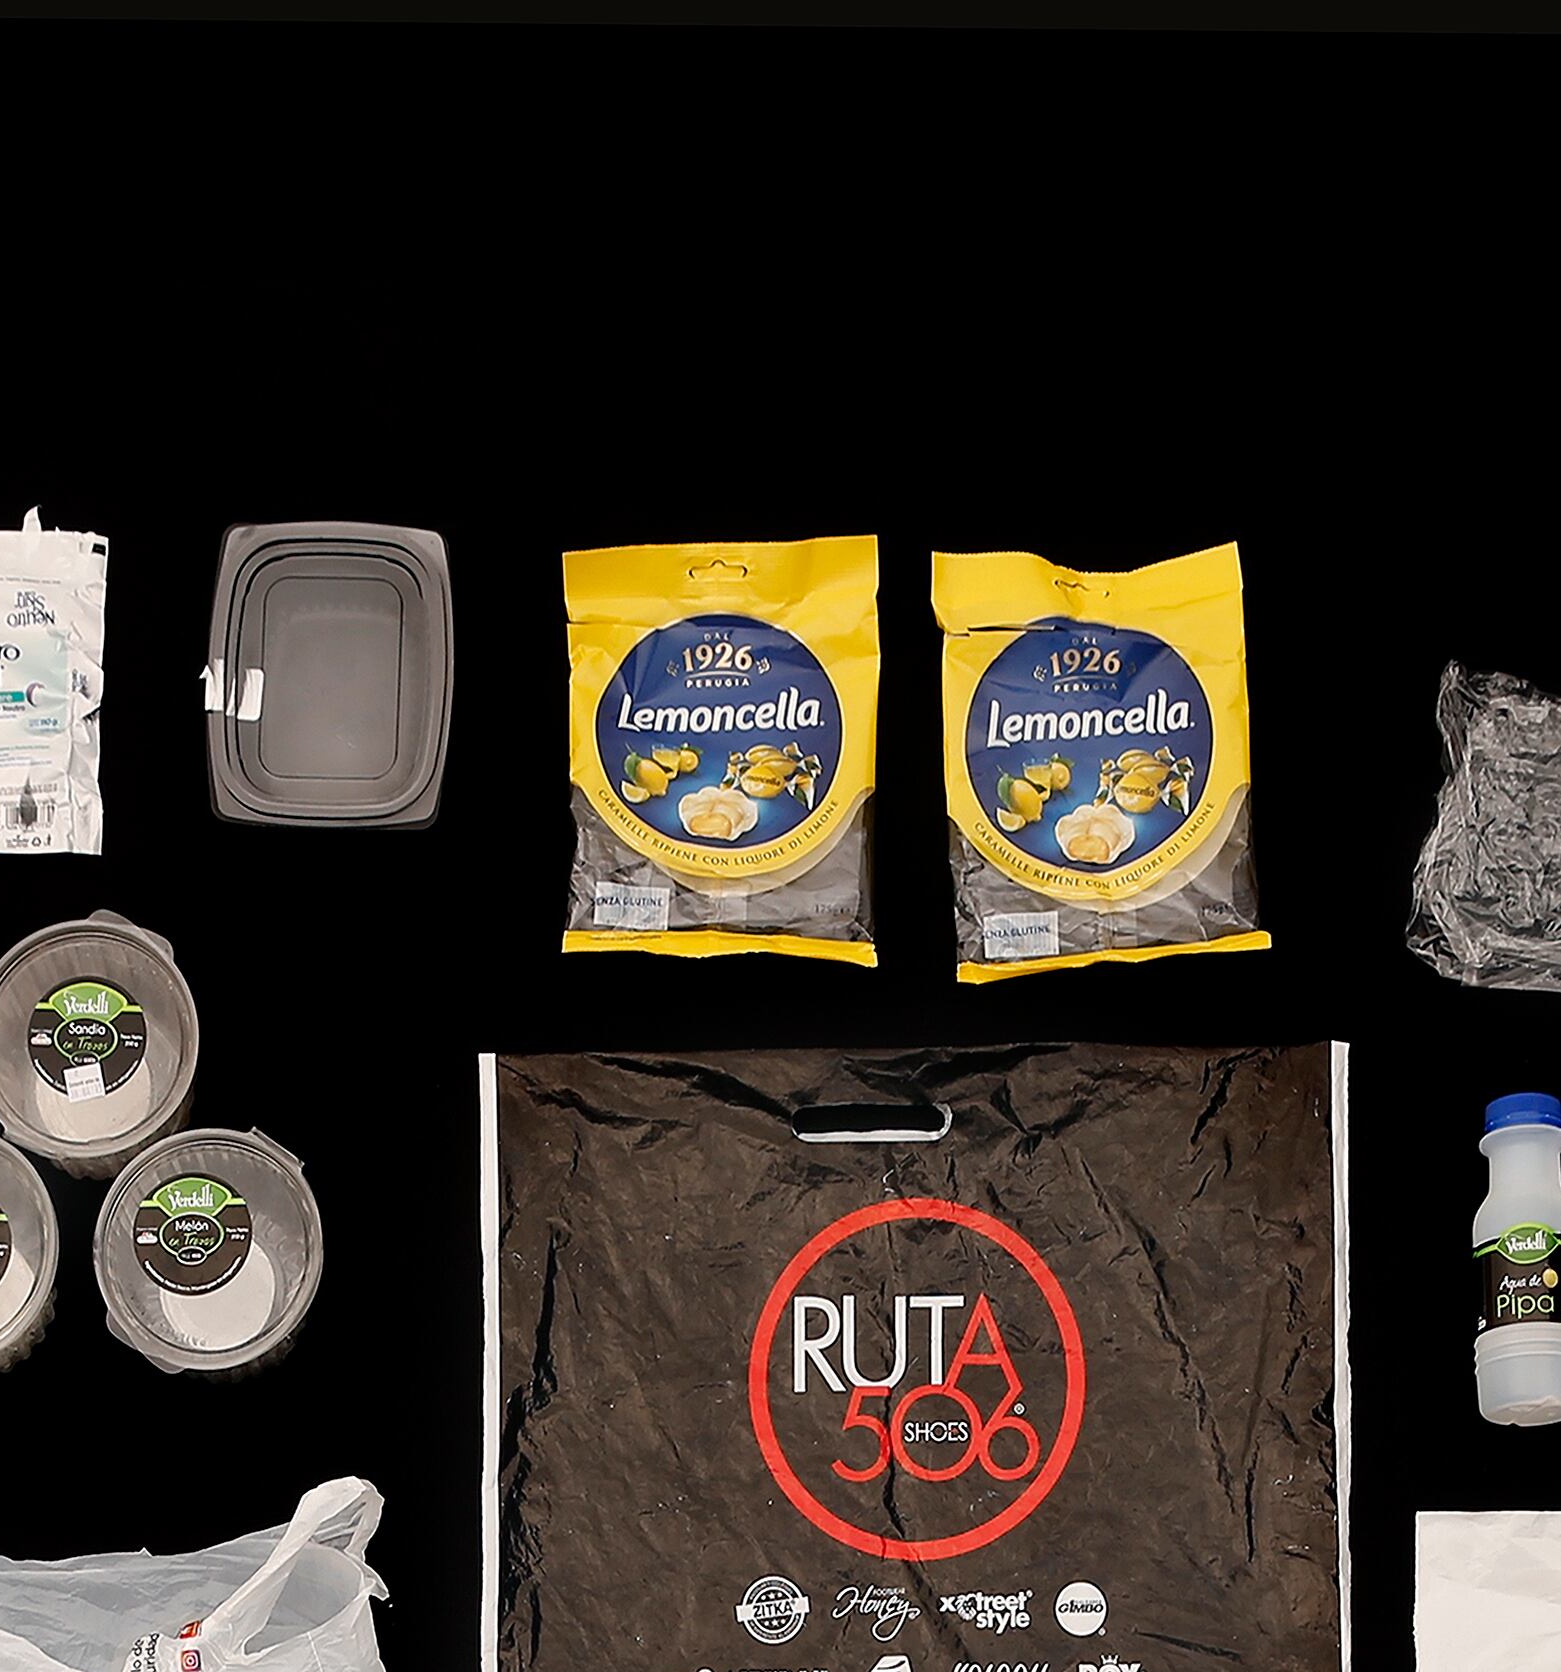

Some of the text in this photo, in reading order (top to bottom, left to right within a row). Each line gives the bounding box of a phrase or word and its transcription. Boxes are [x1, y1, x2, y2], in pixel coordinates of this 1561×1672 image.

[704, 632, 731, 643] DAL
[682, 643, 753, 673] 1926
[1049, 647, 1122, 678] 1926
[685, 678, 751, 689] PERUGIA
[1052, 682, 1118, 693] PERUGIA
[618, 686, 825, 734] Lemoncella
[987, 688, 1195, 748] Lemoncella
[702, 855, 730, 866] CON
[789, 838, 803, 850] DI
[803, 800, 839, 841] LIMONE
[1085, 880, 1111, 890] CON
[1114, 856, 1165, 888] LIQUORE
[1166, 842, 1181, 856] DI
[1182, 800, 1216, 842] LIMONE
[168, 1184, 214, 1209] Verdelli
[1504, 1232, 1547, 1255] Verdelli
[1496, 1288, 1555, 1318] Pipa
[793, 1292, 1025, 1393] RUTA
[831, 1385, 1041, 1483] 506
[904, 1421, 969, 1442] SHOES
[753, 1603, 793, 1617] ZITKA
[832, 1585, 921, 1642] Honey
[976, 1606, 1030, 1634] style
